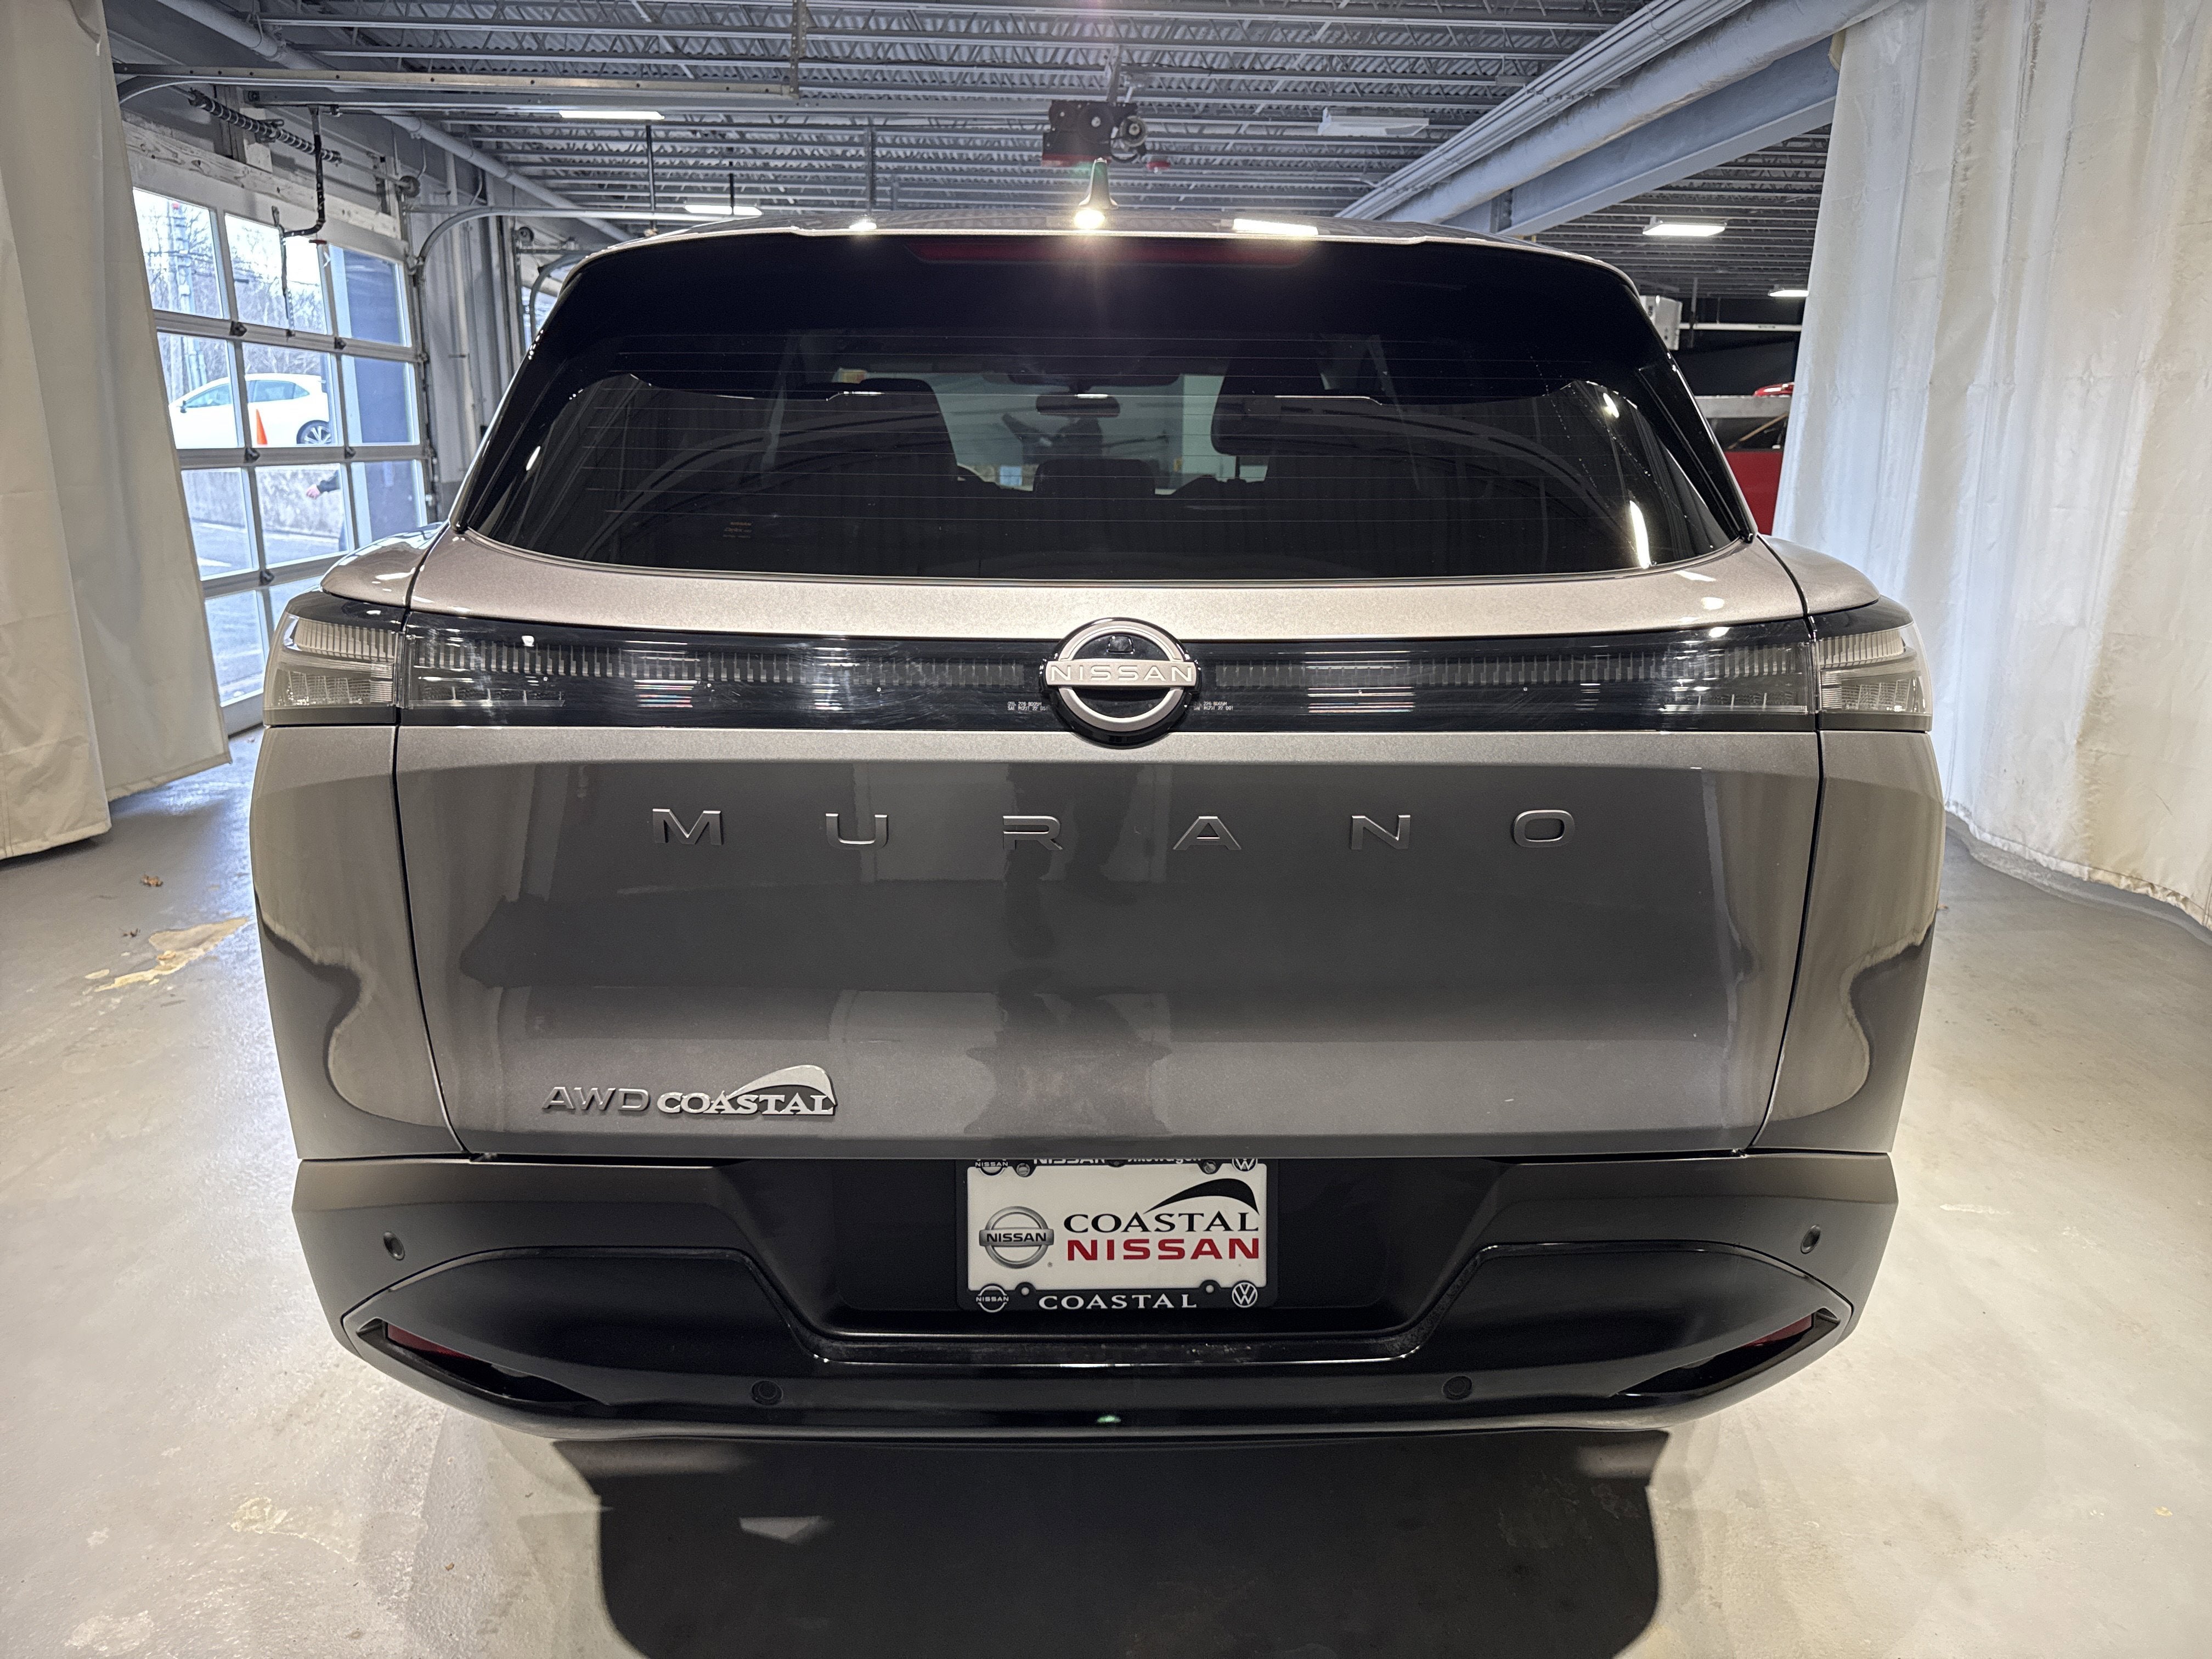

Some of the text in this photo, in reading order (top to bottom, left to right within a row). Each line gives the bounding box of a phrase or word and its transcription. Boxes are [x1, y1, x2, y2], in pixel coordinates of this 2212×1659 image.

[1050, 665, 1193, 682] NISSAN
[652, 808, 1576, 851] MURANO
[541, 1086, 836, 1115] AWD COASTAL
[1064, 1211, 1259, 1233] COASTAL
[986, 1233, 1046, 1243] NISSAN
[1068, 1238, 1259, 1261] NISSAN
[1039, 1293, 1197, 1310] COASTAL
